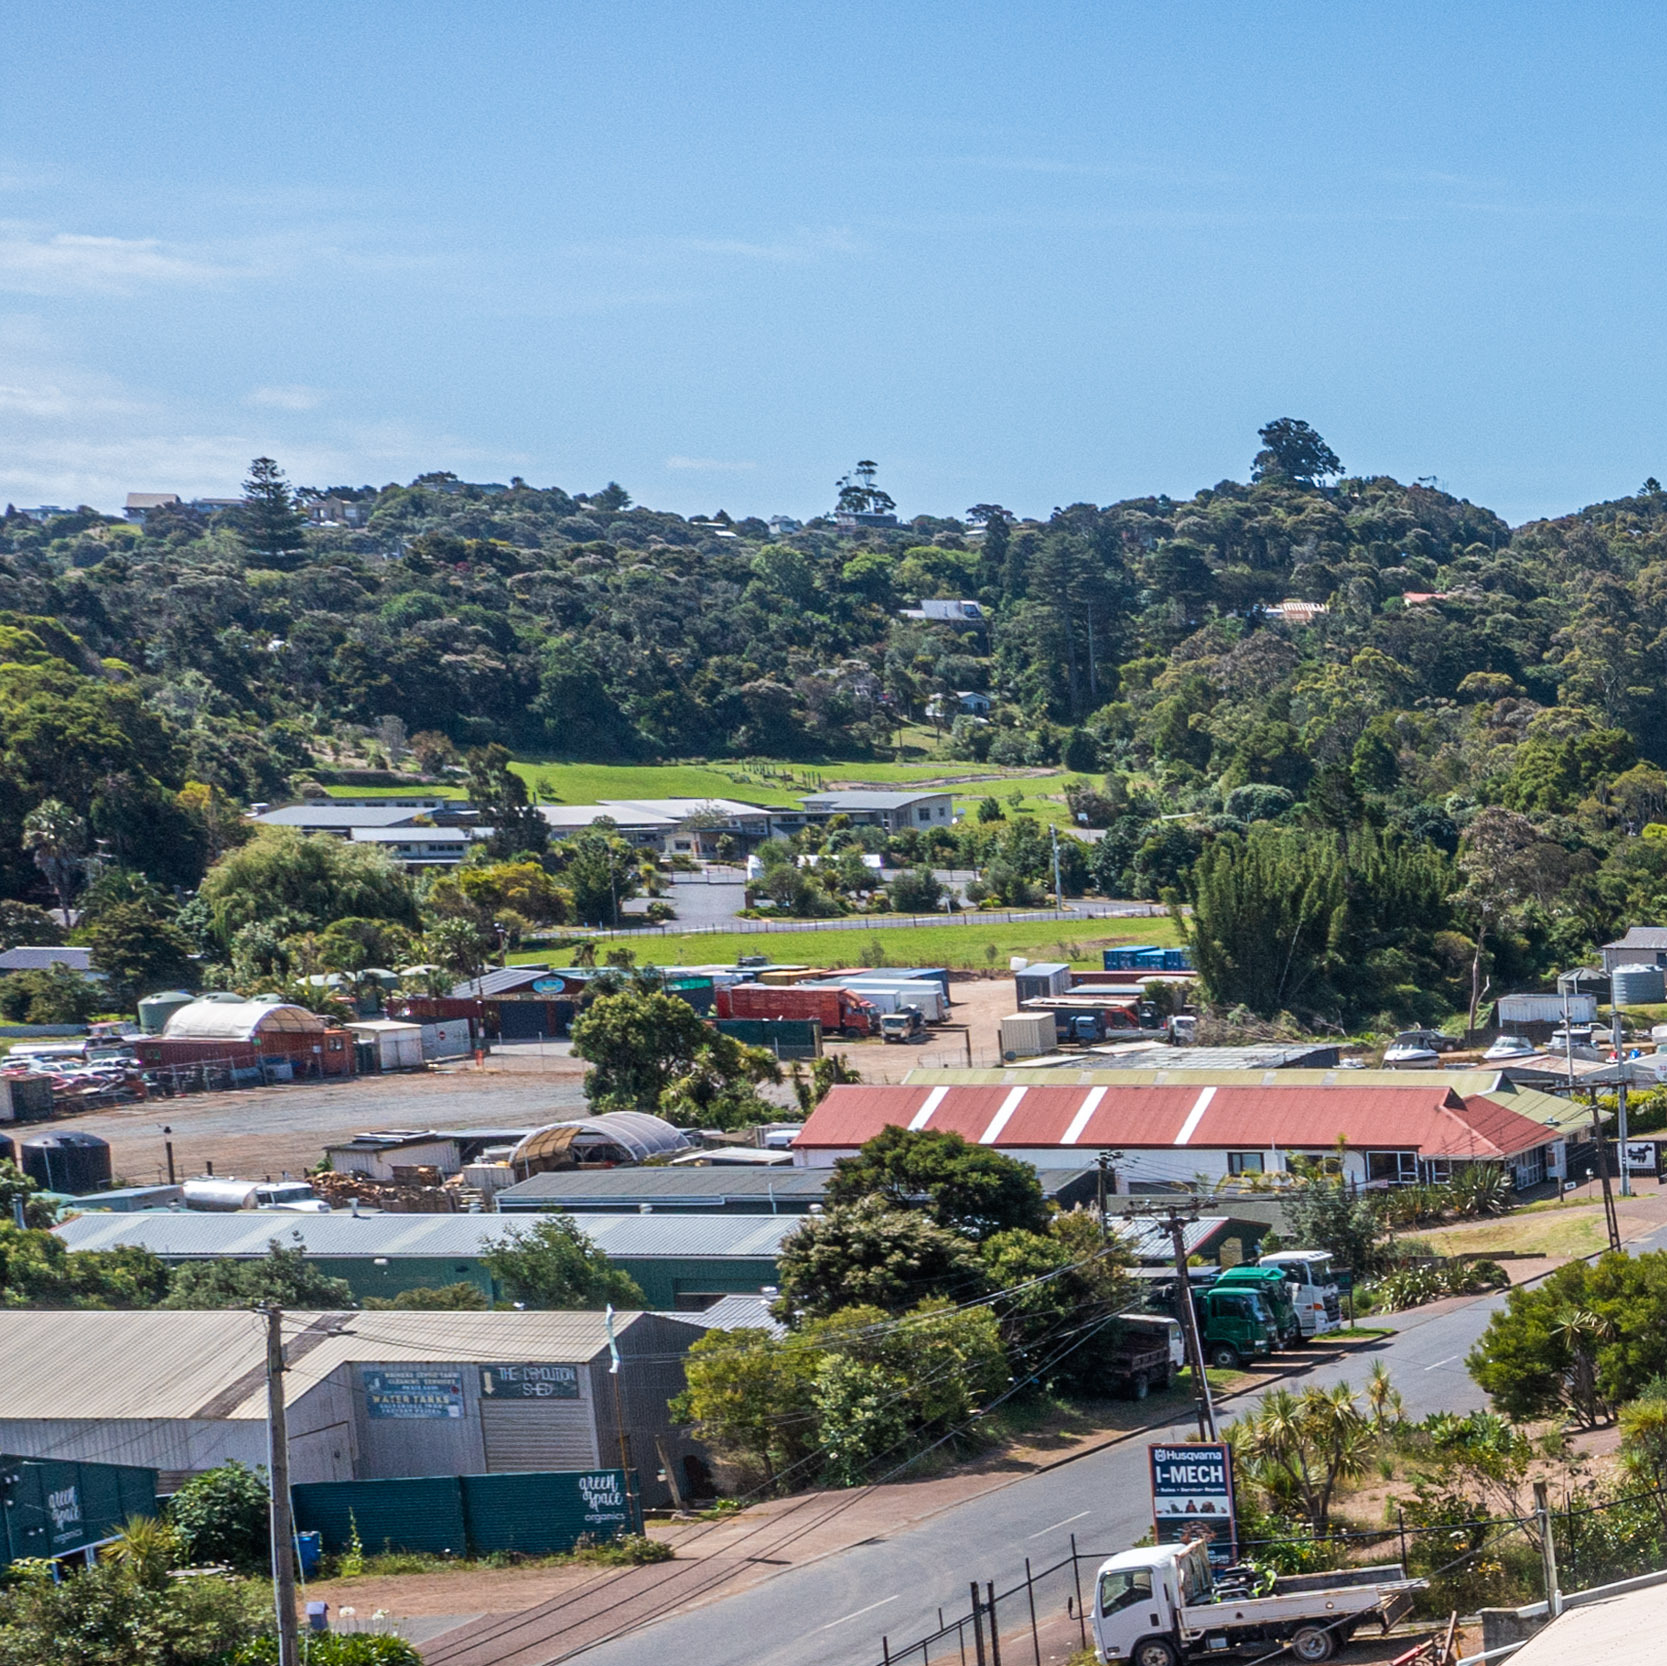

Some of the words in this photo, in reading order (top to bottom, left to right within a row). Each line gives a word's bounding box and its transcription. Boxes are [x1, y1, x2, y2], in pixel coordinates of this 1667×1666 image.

[498, 1366, 518, 1380] THE
[372, 1395, 410, 1404] WATER
[414, 1395, 450, 1404] TANKS
[1167, 1451, 1222, 1461] Husqvarna
[1156, 1466, 1223, 1483] I-MECH
[579, 1474, 618, 1492] green
[583, 1490, 623, 1512] space
[585, 1513, 626, 1524] organics
